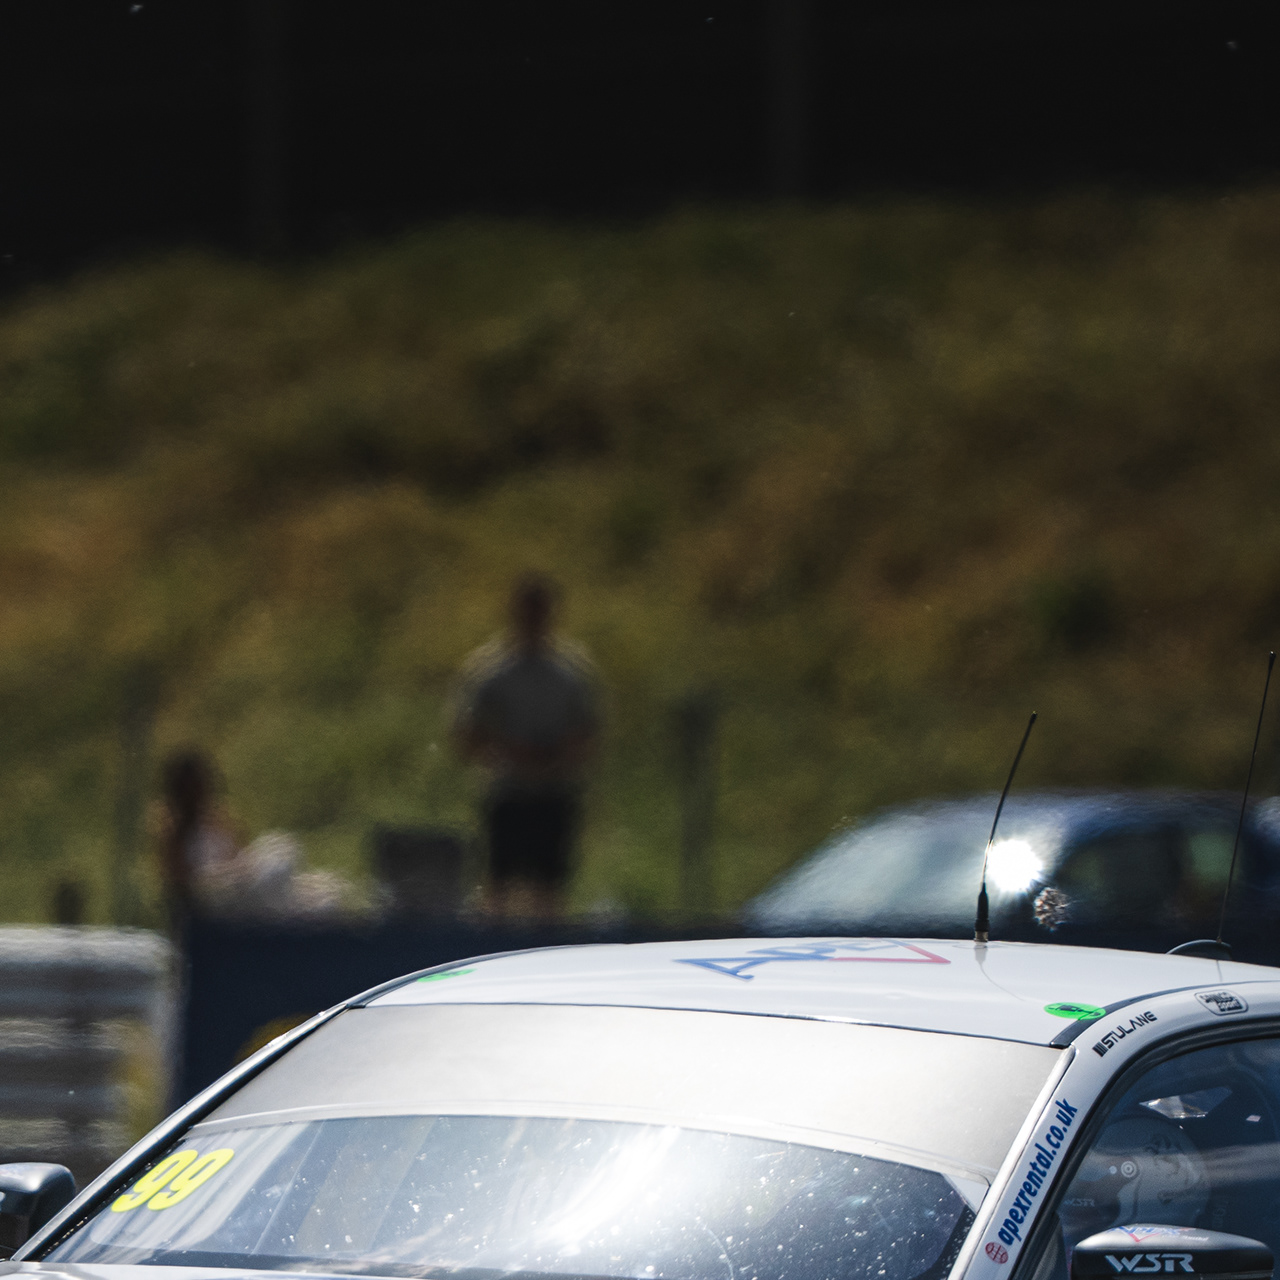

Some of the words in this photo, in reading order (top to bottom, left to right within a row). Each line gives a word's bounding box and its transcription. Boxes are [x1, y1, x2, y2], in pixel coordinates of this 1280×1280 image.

[111, 1148, 234, 1213] 99
[997, 1098, 1078, 1246] apexrental.co.uk
[1105, 1253, 1195, 1273] WSR
